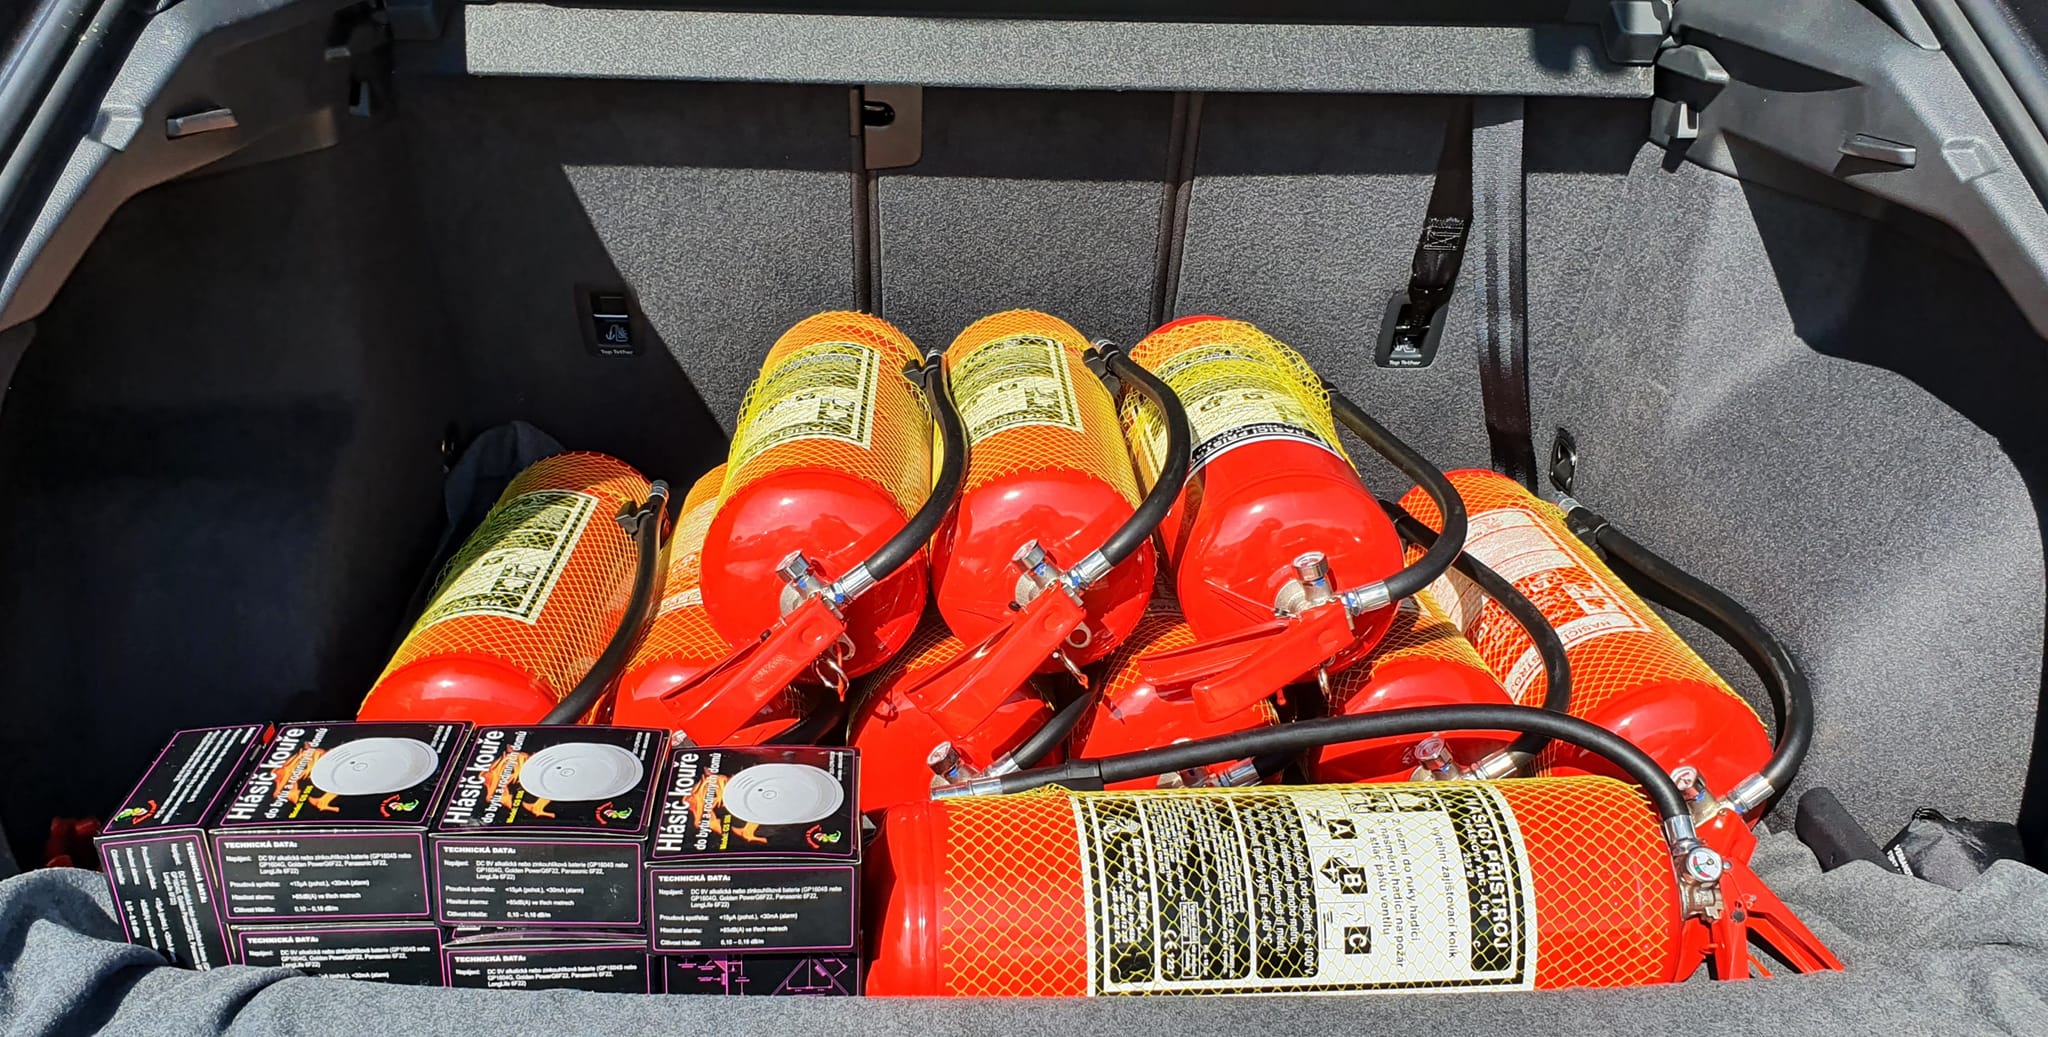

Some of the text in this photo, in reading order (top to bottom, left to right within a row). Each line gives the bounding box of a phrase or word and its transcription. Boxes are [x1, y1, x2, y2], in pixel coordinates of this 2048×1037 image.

[226, 728, 305, 820] Hlásič kouře
[264, 808, 279, 819] do
[310, 728, 328, 747] domů
[444, 776, 485, 823] Hlásič
[466, 730, 504, 772] kouře
[481, 813, 495, 823] do
[510, 730, 527, 750] domů
[656, 753, 699, 851] Hlásič kouře
[693, 838, 707, 850] do
[708, 753, 721, 773] domů
[1331, 823, 1352, 835] A
[1395, 827, 1411, 856] vezmi
[224, 840, 272, 849] TECHNICKÁ
[443, 846, 491, 854] TECHNICKÁ
[658, 874, 705, 882] TECHNICKÁ
[1403, 857, 1412, 873] do
[1344, 873, 1361, 887] B
[1404, 876, 1416, 901] ruky
[1391, 878, 1402, 916] hadici
[1483, 850, 1509, 948] PŘÍSTROJ
[1380, 895, 1392, 935] ventilu
[1395, 917, 1404, 931] na
[1409, 904, 1420, 941] hadici
[1304, 933, 1313, 944] do
[1349, 933, 1367, 948] C
[1304, 947, 1314, 967] 1000
